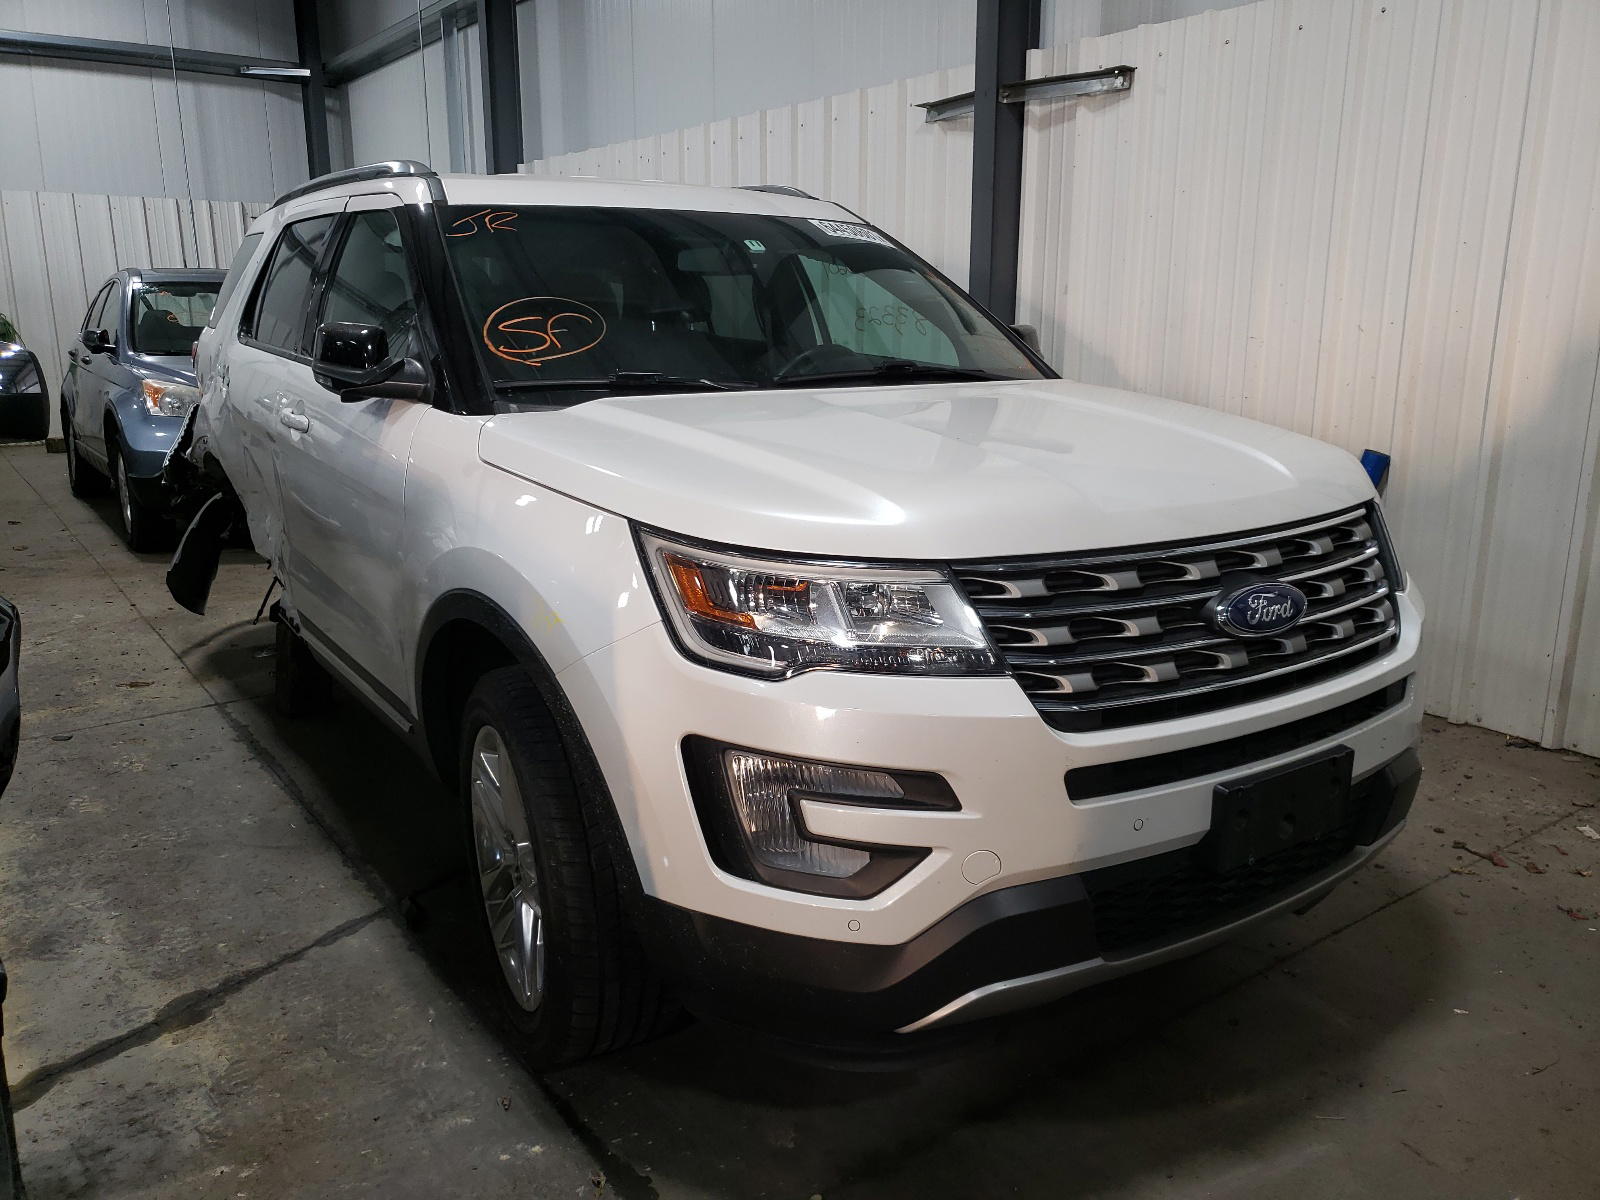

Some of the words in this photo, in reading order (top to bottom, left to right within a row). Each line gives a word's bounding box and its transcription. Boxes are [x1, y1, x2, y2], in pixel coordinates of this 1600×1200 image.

[446, 208, 519, 237] JR
[497, 312, 593, 353] SF
[1246, 590, 1294, 625] Ford
